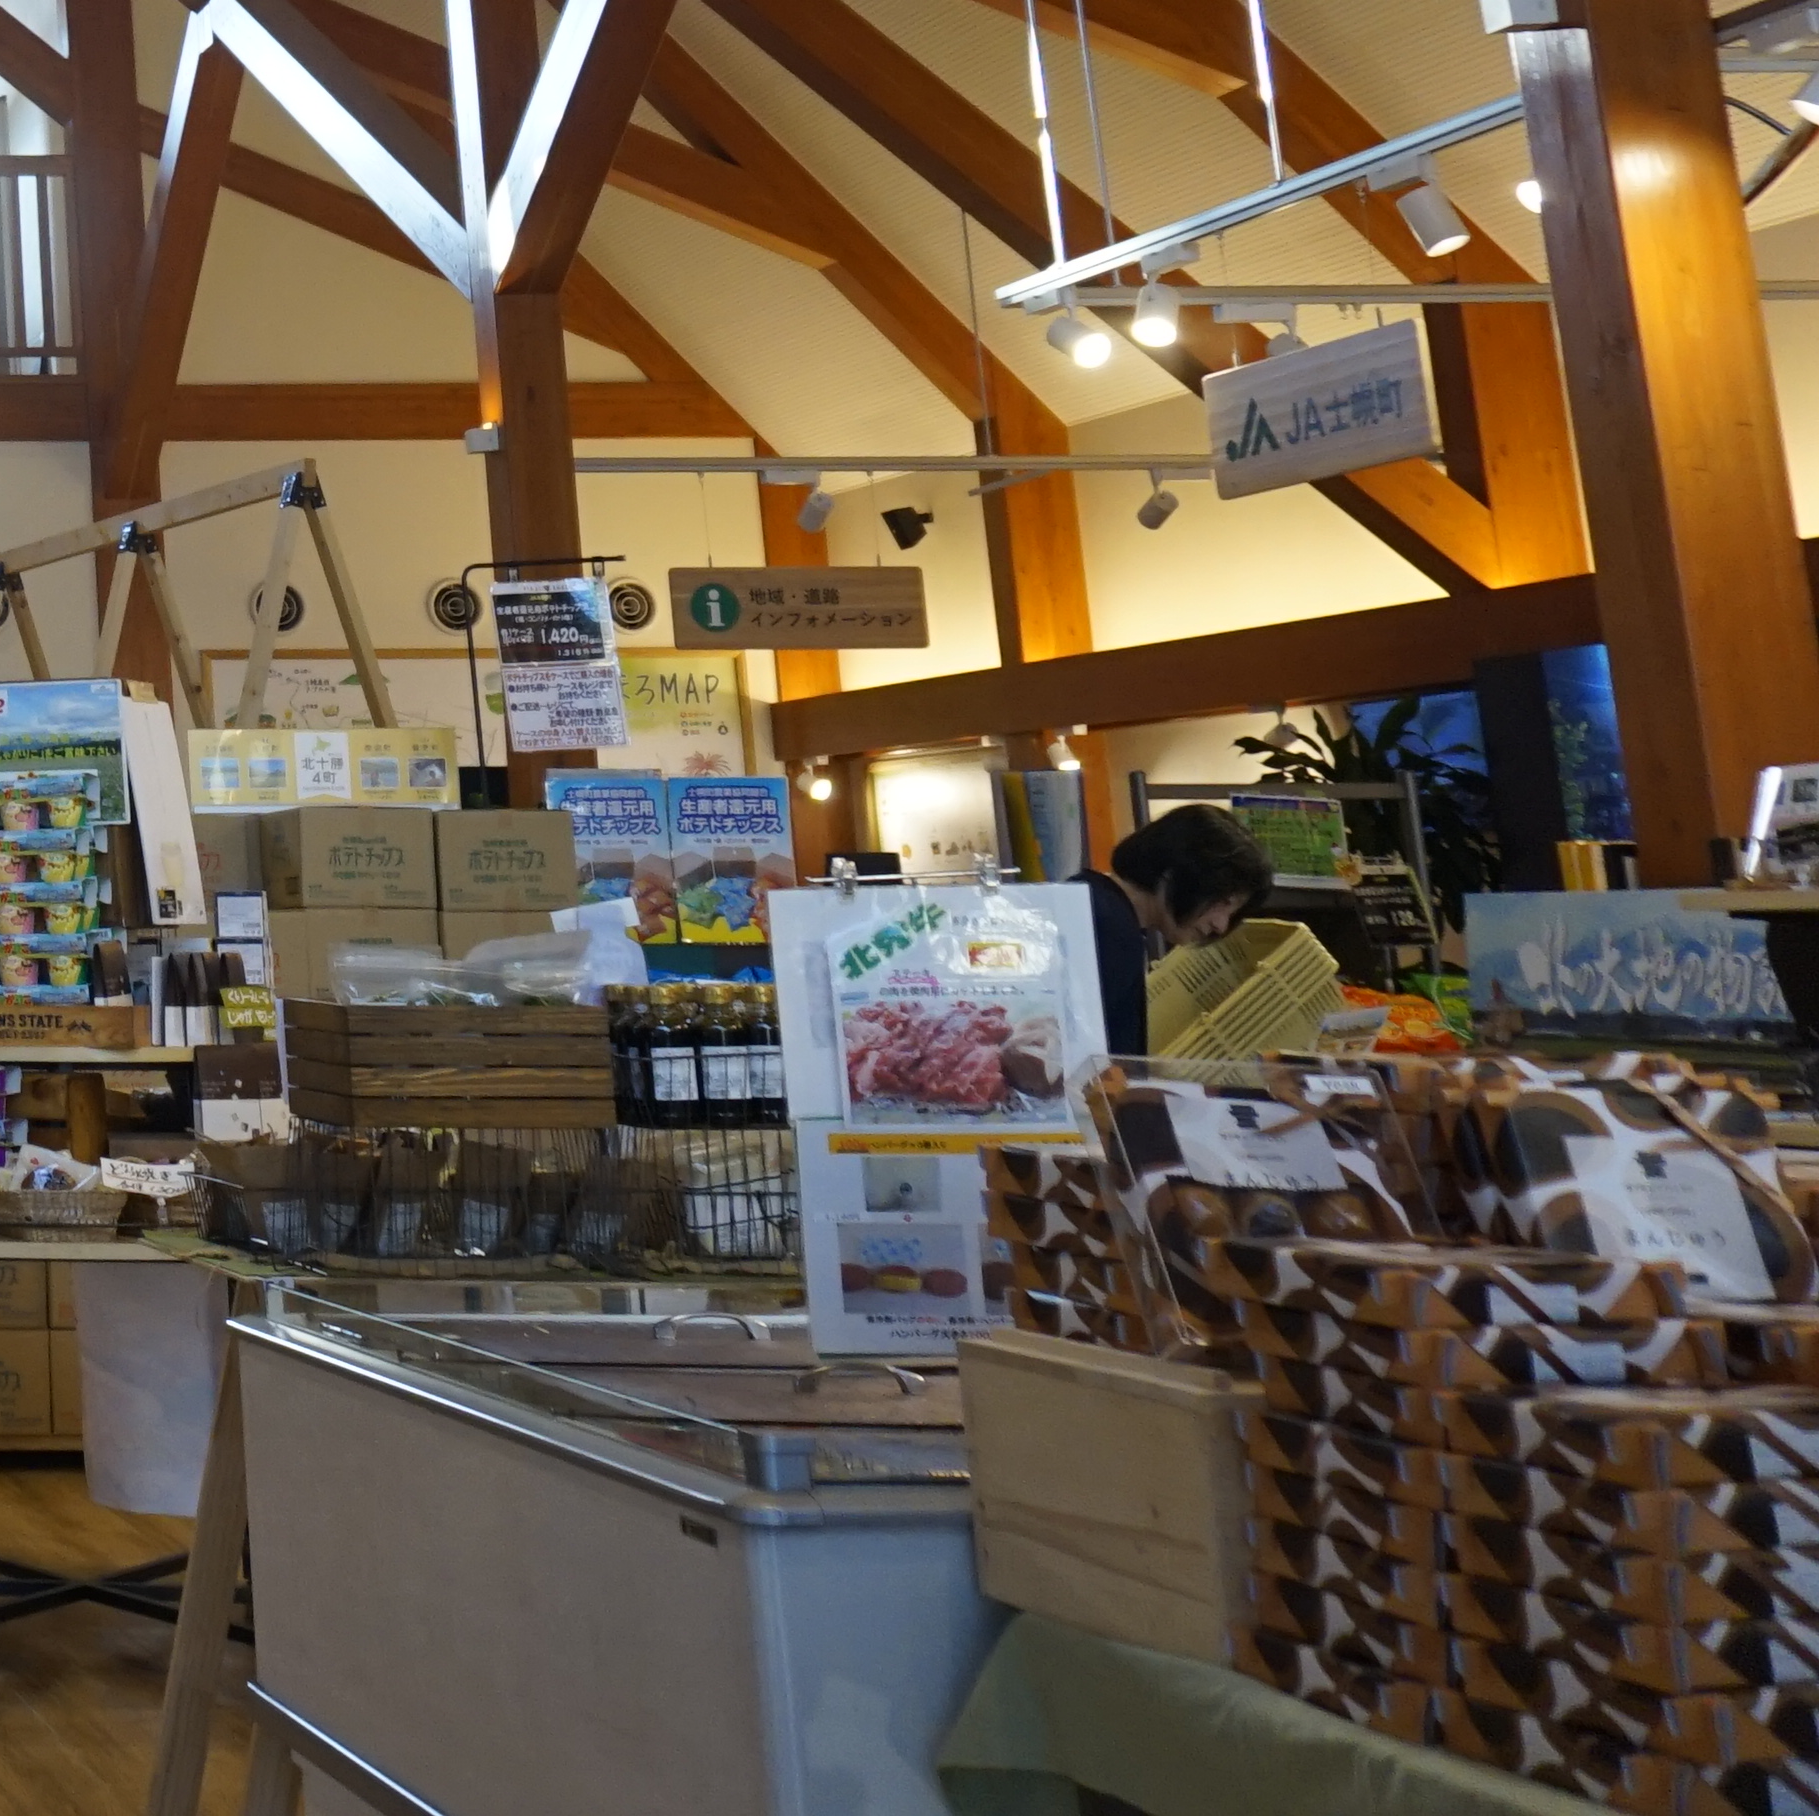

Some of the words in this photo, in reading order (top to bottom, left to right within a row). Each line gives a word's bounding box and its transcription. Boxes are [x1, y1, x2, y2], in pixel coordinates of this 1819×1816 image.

[750, 612, 913, 629] インフォメーション
[680, 797, 778, 815] 生産者還元用
[572, 816, 661, 835] テトチップス
[677, 816, 783, 834] ポテトチップス
[19, 1014, 64, 1029] STATE
